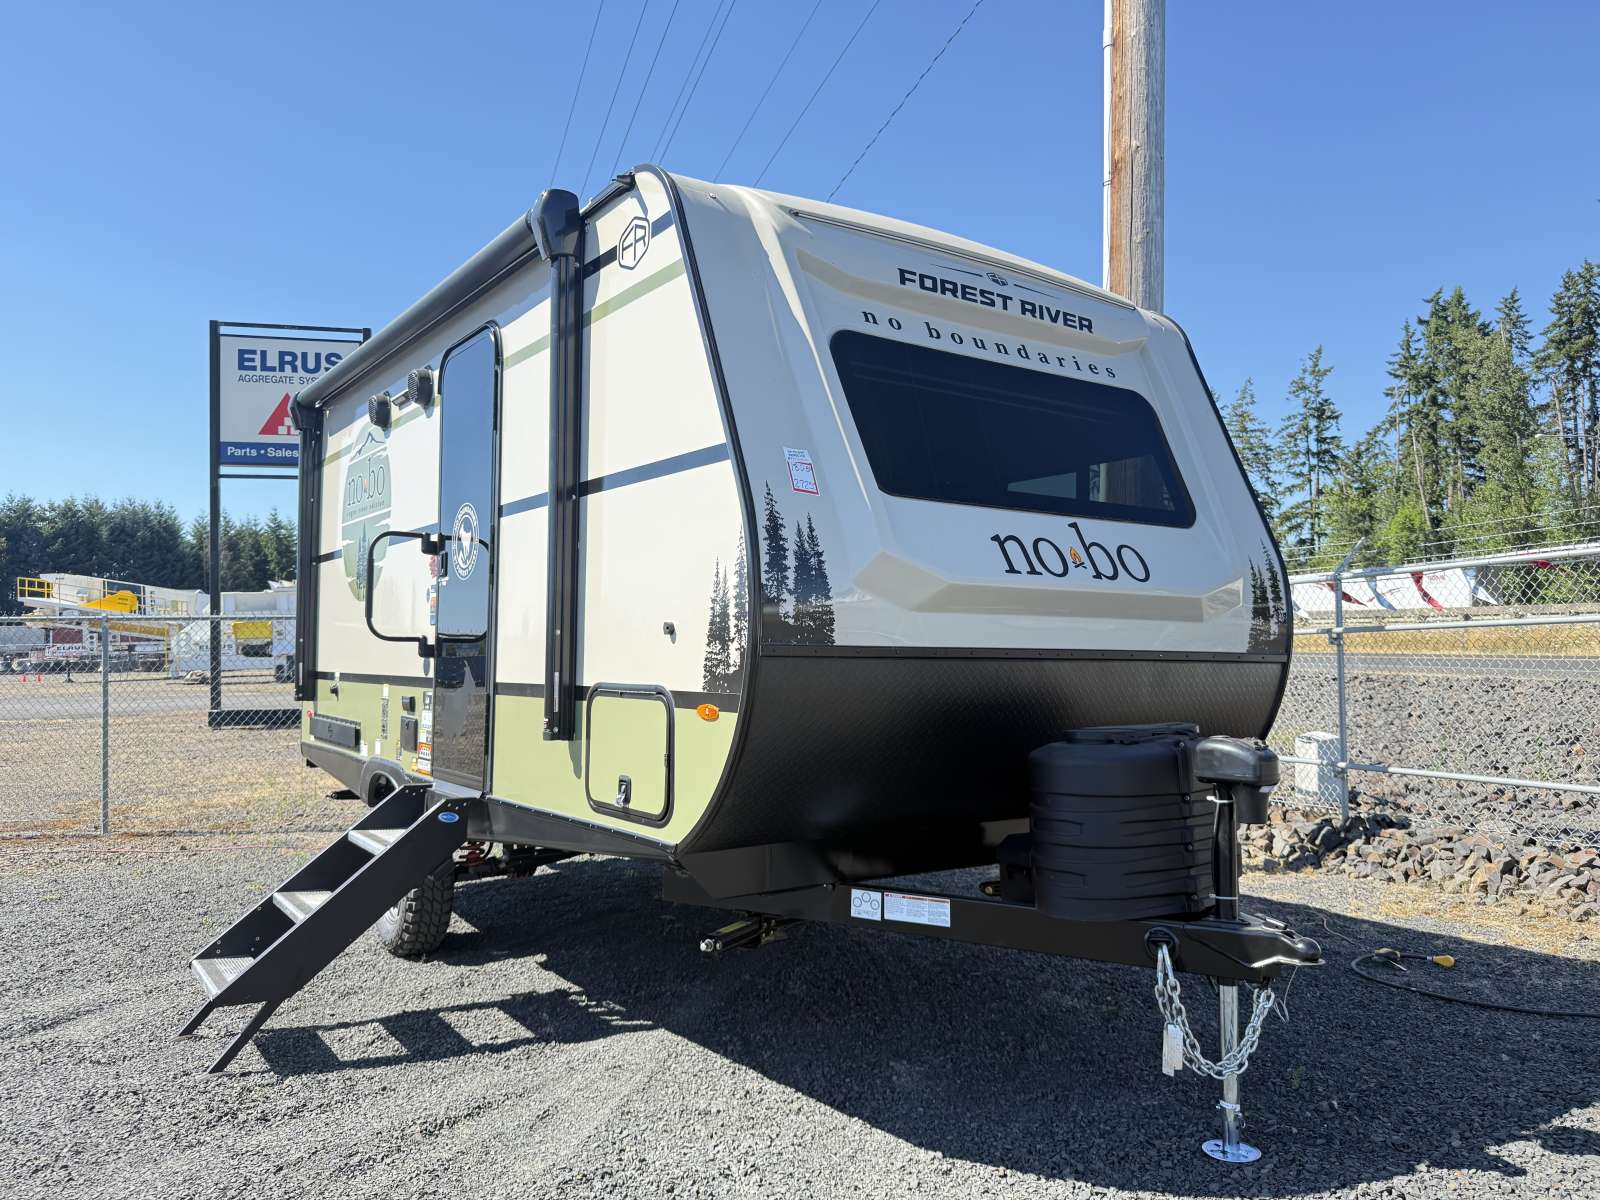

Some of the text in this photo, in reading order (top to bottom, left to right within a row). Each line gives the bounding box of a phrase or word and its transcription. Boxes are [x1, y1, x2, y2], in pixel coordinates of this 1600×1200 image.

[897, 267, 1094, 334] FOREST RIVER
[861, 311, 1117, 379] no boundaries
[237, 348, 343, 374] ELRUS
[238, 374, 294, 385] AGGREGATE
[227, 446, 298, 458] Parts Sales
